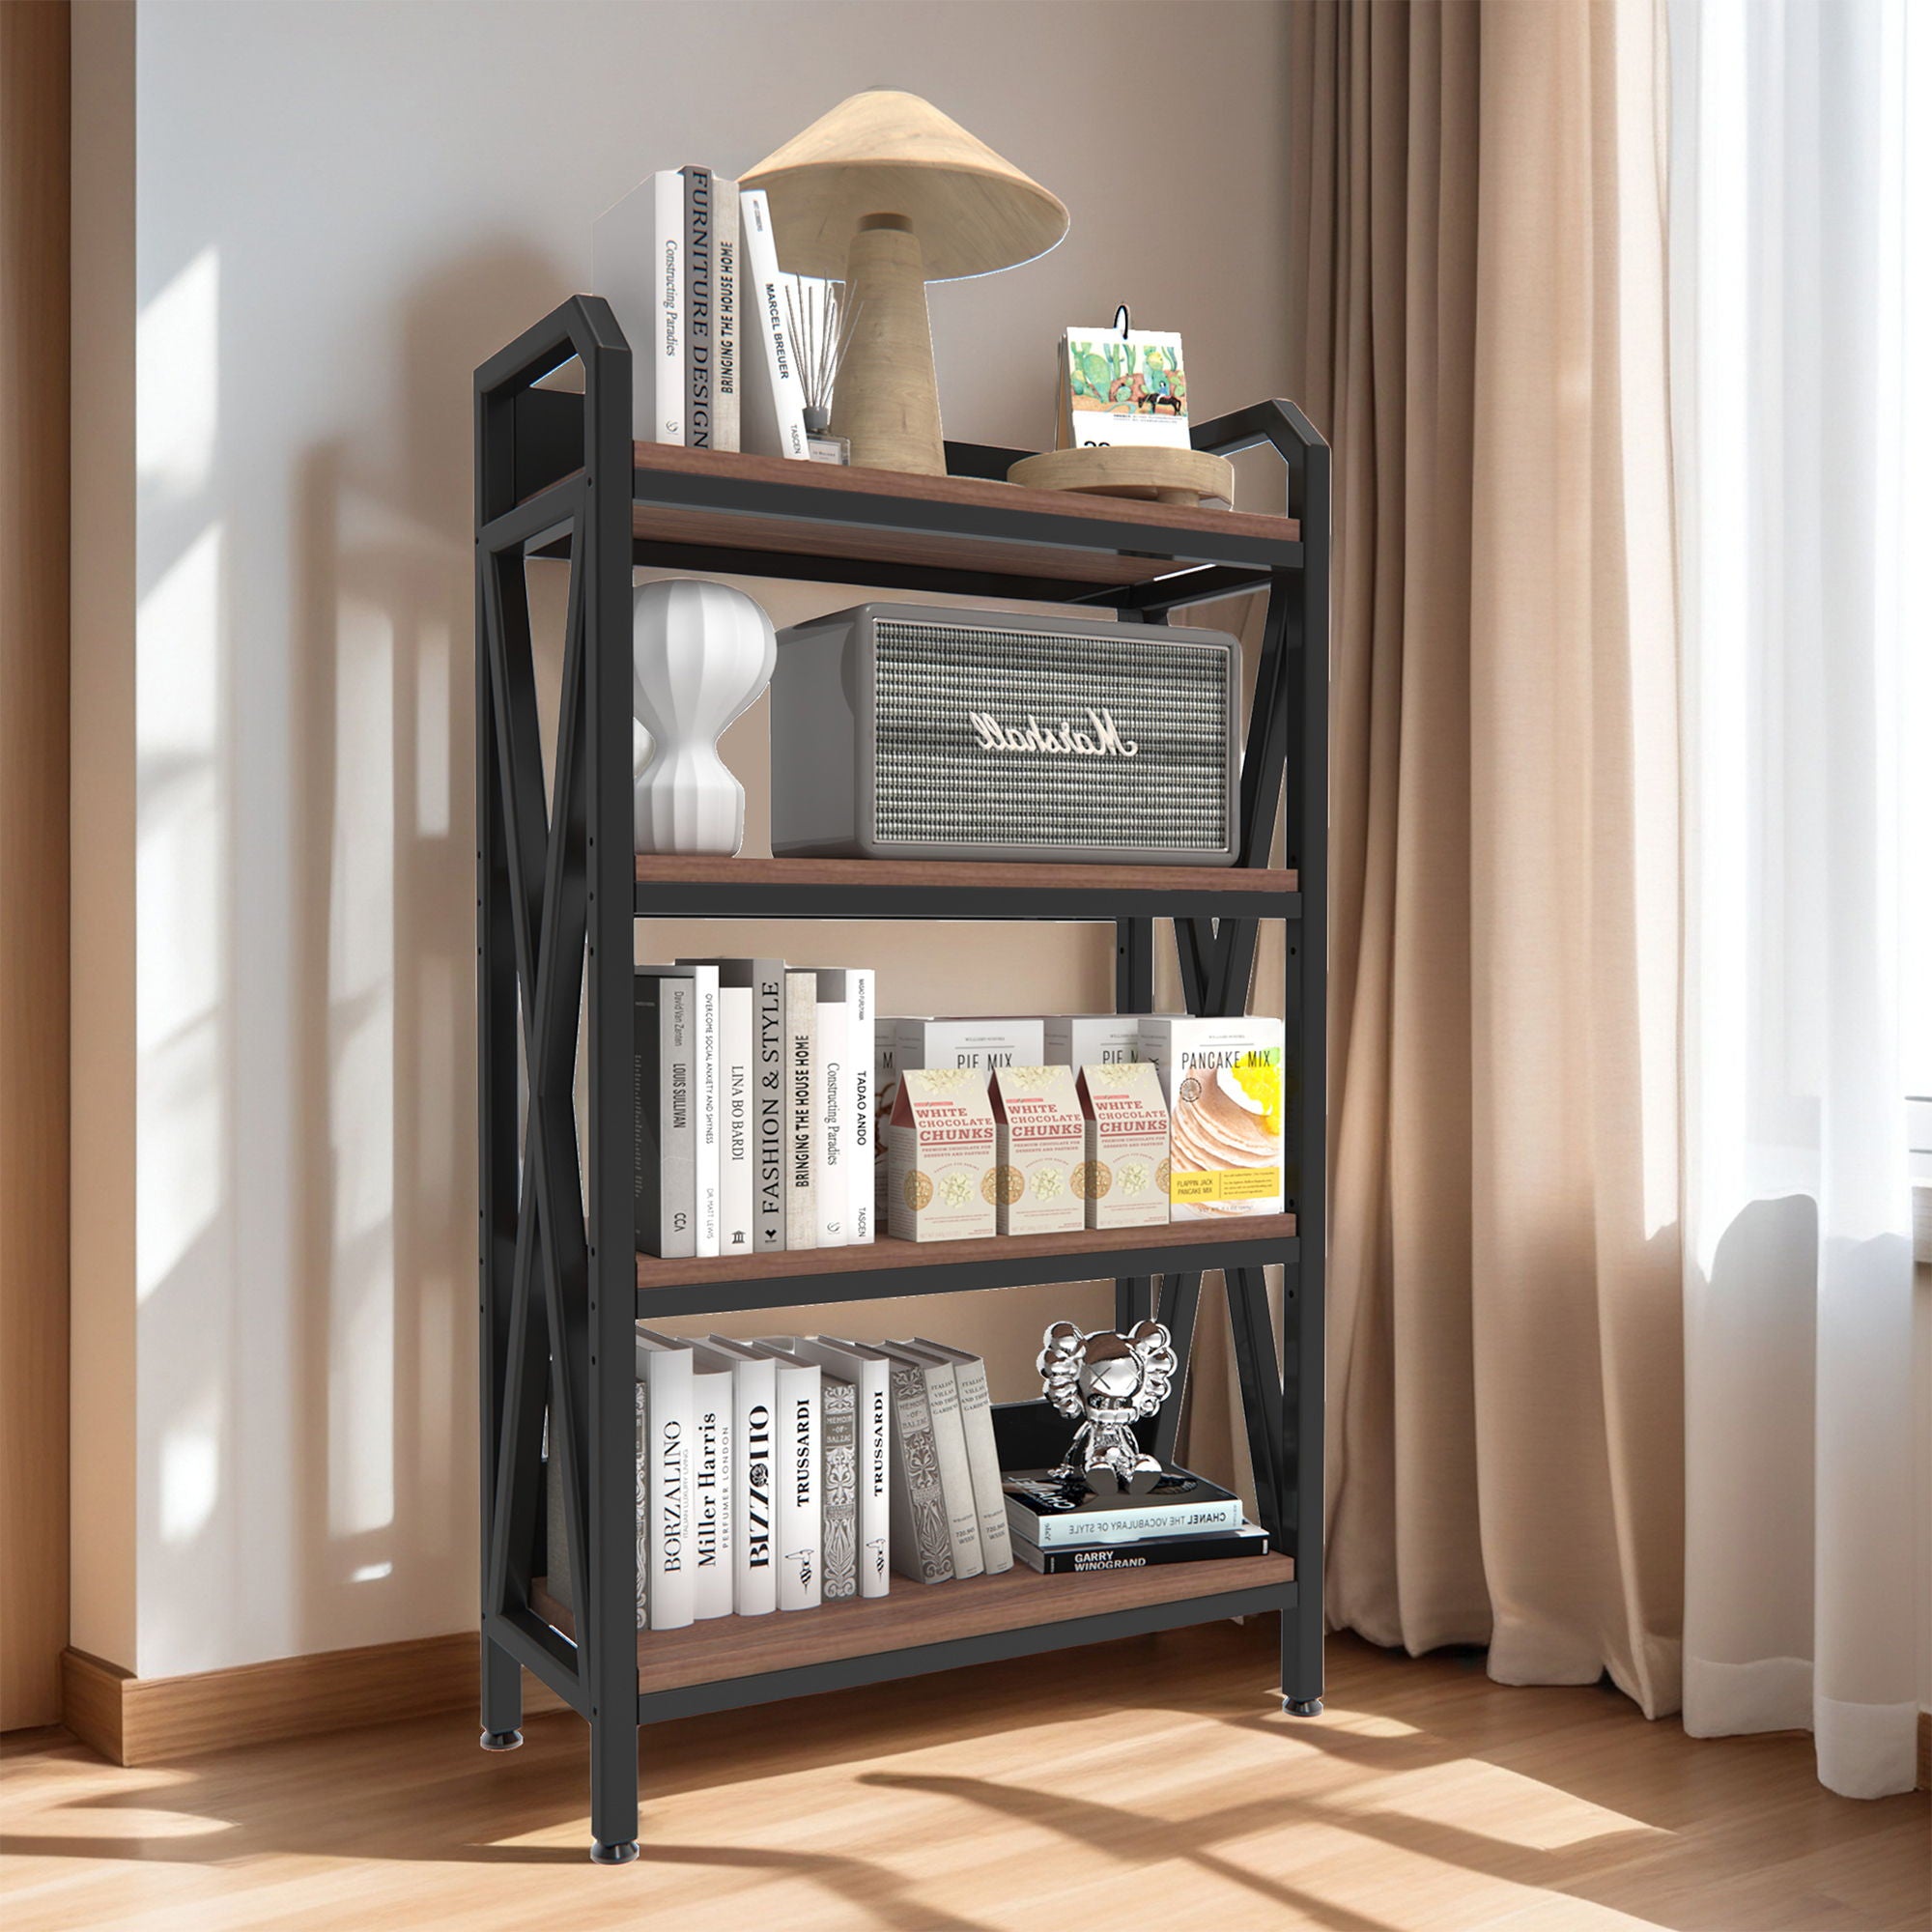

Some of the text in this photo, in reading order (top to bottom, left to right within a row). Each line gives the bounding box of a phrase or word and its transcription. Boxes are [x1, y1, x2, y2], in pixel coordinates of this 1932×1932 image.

[664, 240, 678, 308] Constructing
[693, 171, 708, 448] FURNITURE DESIGN
[721, 242, 733, 393] BRINGING THE HOUSE HOME
[765, 283, 789, 379] MARCEL BREUER
[674, 991, 684, 1009] David
[674, 1010, 684, 1023] Van
[987, 1053, 1012, 1070] MIX
[1181, 1050, 1270, 1069] PANCAKE MIX
[673, 1064, 686, 1128] LOUIS SULLIVAN
[762, 982, 779, 1213] FASHION & STYLE
[824, 1063, 839, 1122] Constructing
[732, 1065, 744, 1160] LINA BO BARDI
[795, 1036, 809, 1187] BRINGING THE HOUSE HOME
[857, 1071, 867, 1146] TADAO ANDO
[916, 1108, 967, 1118] WHITE
[1008, 1104, 1058, 1114] WHITE
[1095, 1100, 1143, 1110] WHITE
[919, 1118, 993, 1128] CHOCOLATE
[1010, 1114, 1081, 1123] CHOCOLATE
[1098, 1110, 1166, 1120] CHOCOLATE
[920, 1128, 993, 1141] CHUNKS
[1011, 1123, 1082, 1137] CHUNKS
[1099, 1120, 1167, 1132] CHUNKS
[797, 1399, 810, 1507] TRUSSARDI
[874, 1391, 883, 1496] TRUSSARDI
[664, 1421, 681, 1574] BORZALINO
[697, 1412, 716, 1568] Miller Harris
[1074, 1550, 1114, 1563] GARRY
[1074, 1557, 1146, 1572] WINOGRAND
